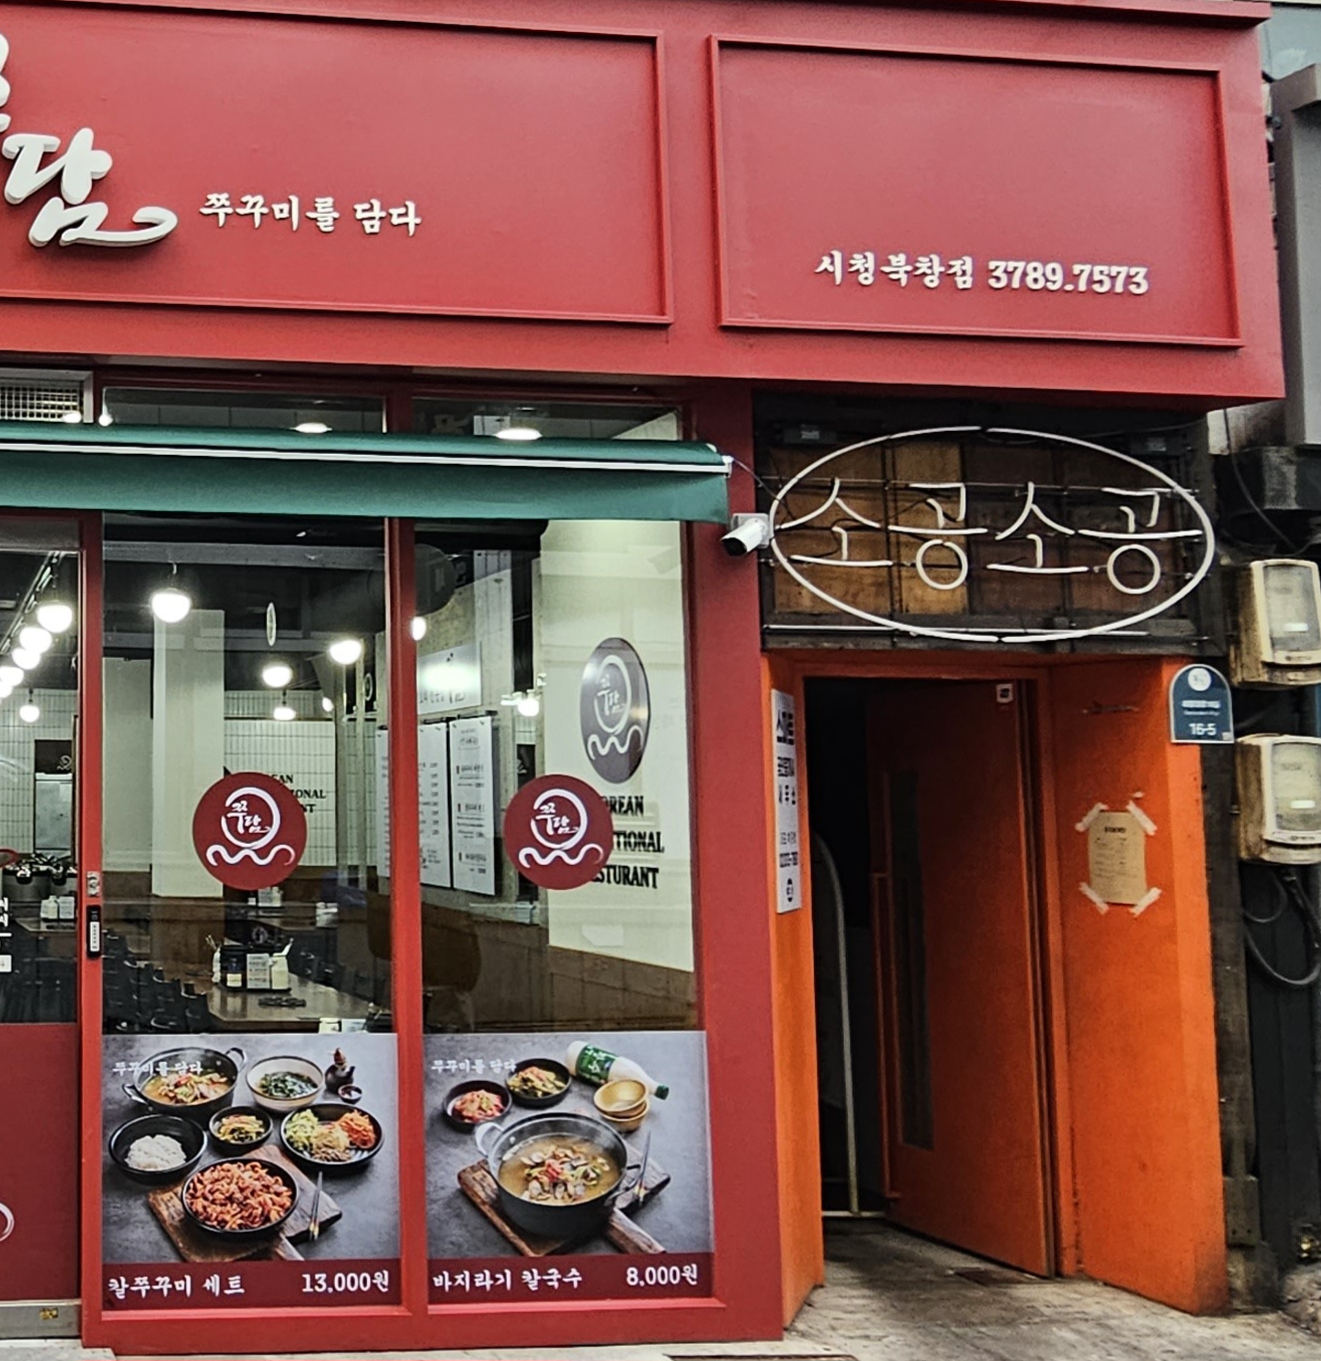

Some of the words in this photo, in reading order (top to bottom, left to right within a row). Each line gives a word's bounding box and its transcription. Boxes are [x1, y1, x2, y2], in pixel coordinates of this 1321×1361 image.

[199, 193, 339, 233] 쭈꾸미를
[354, 199, 422, 237] 담다
[814, 249, 974, 290] 시청북창점
[987, 260, 1150, 295] 3789.7573
[775, 478, 1203, 595] 소공소공
[107, 1274, 193, 1300] 칼쭈꾸미
[201, 1273, 246, 1298] 세트
[431, 1269, 513, 1294] 바지라기
[520, 1267, 584, 1292] 칼국수
